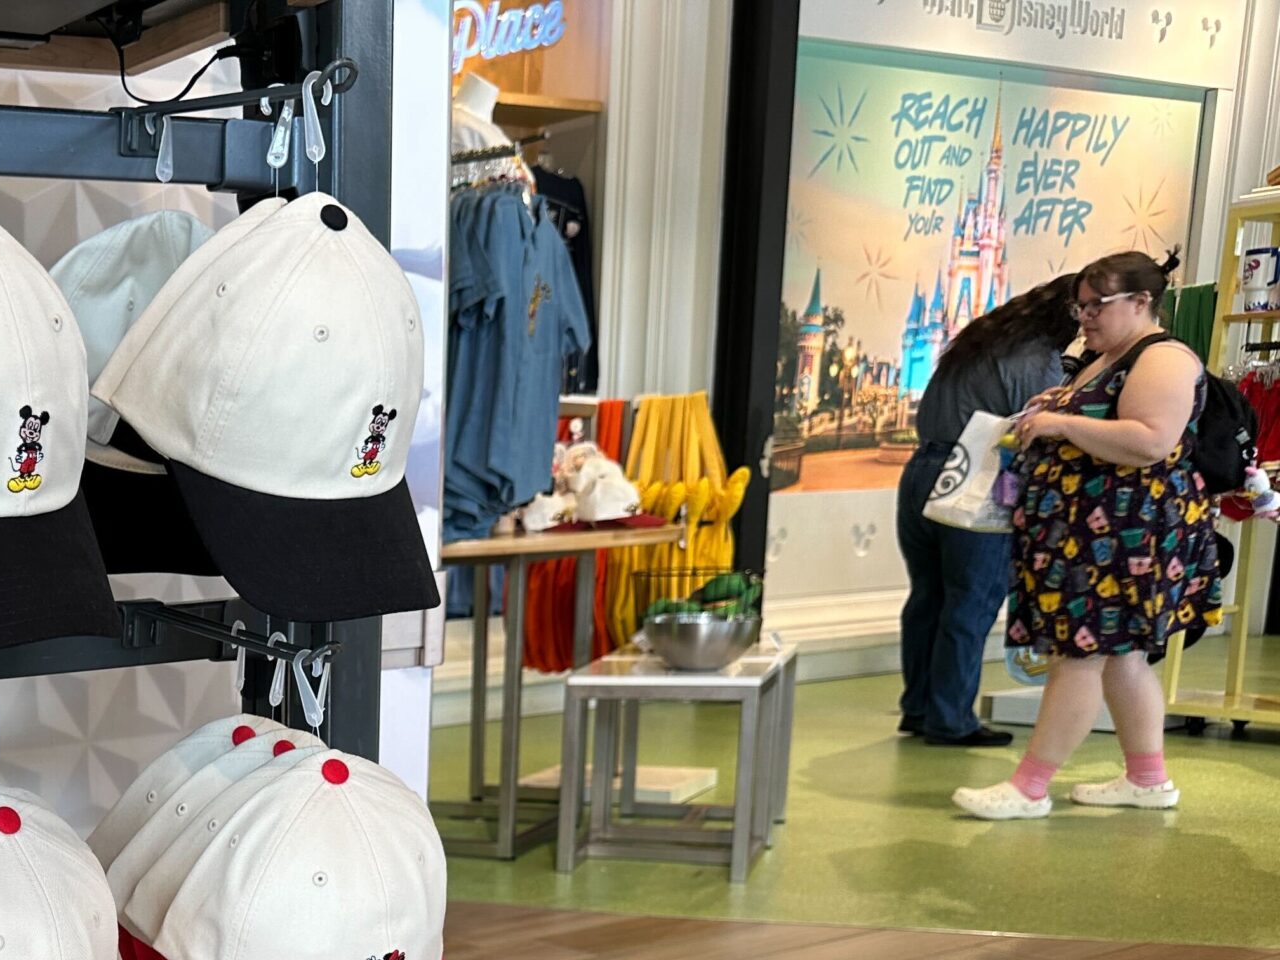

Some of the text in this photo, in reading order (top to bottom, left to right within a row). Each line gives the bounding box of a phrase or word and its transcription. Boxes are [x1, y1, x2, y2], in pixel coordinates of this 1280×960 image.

[452, 0, 565, 75] Place
[1069, 0, 1125, 39] World
[891, 92, 987, 139] REACH
[1012, 106, 1130, 167] HAPPILY
[894, 135, 972, 170] OUT AND
[1015, 150, 1080, 196] EVER
[903, 175, 954, 208] FIND
[904, 209, 944, 242] YOUR
[1013, 197, 1092, 248] AFTER
